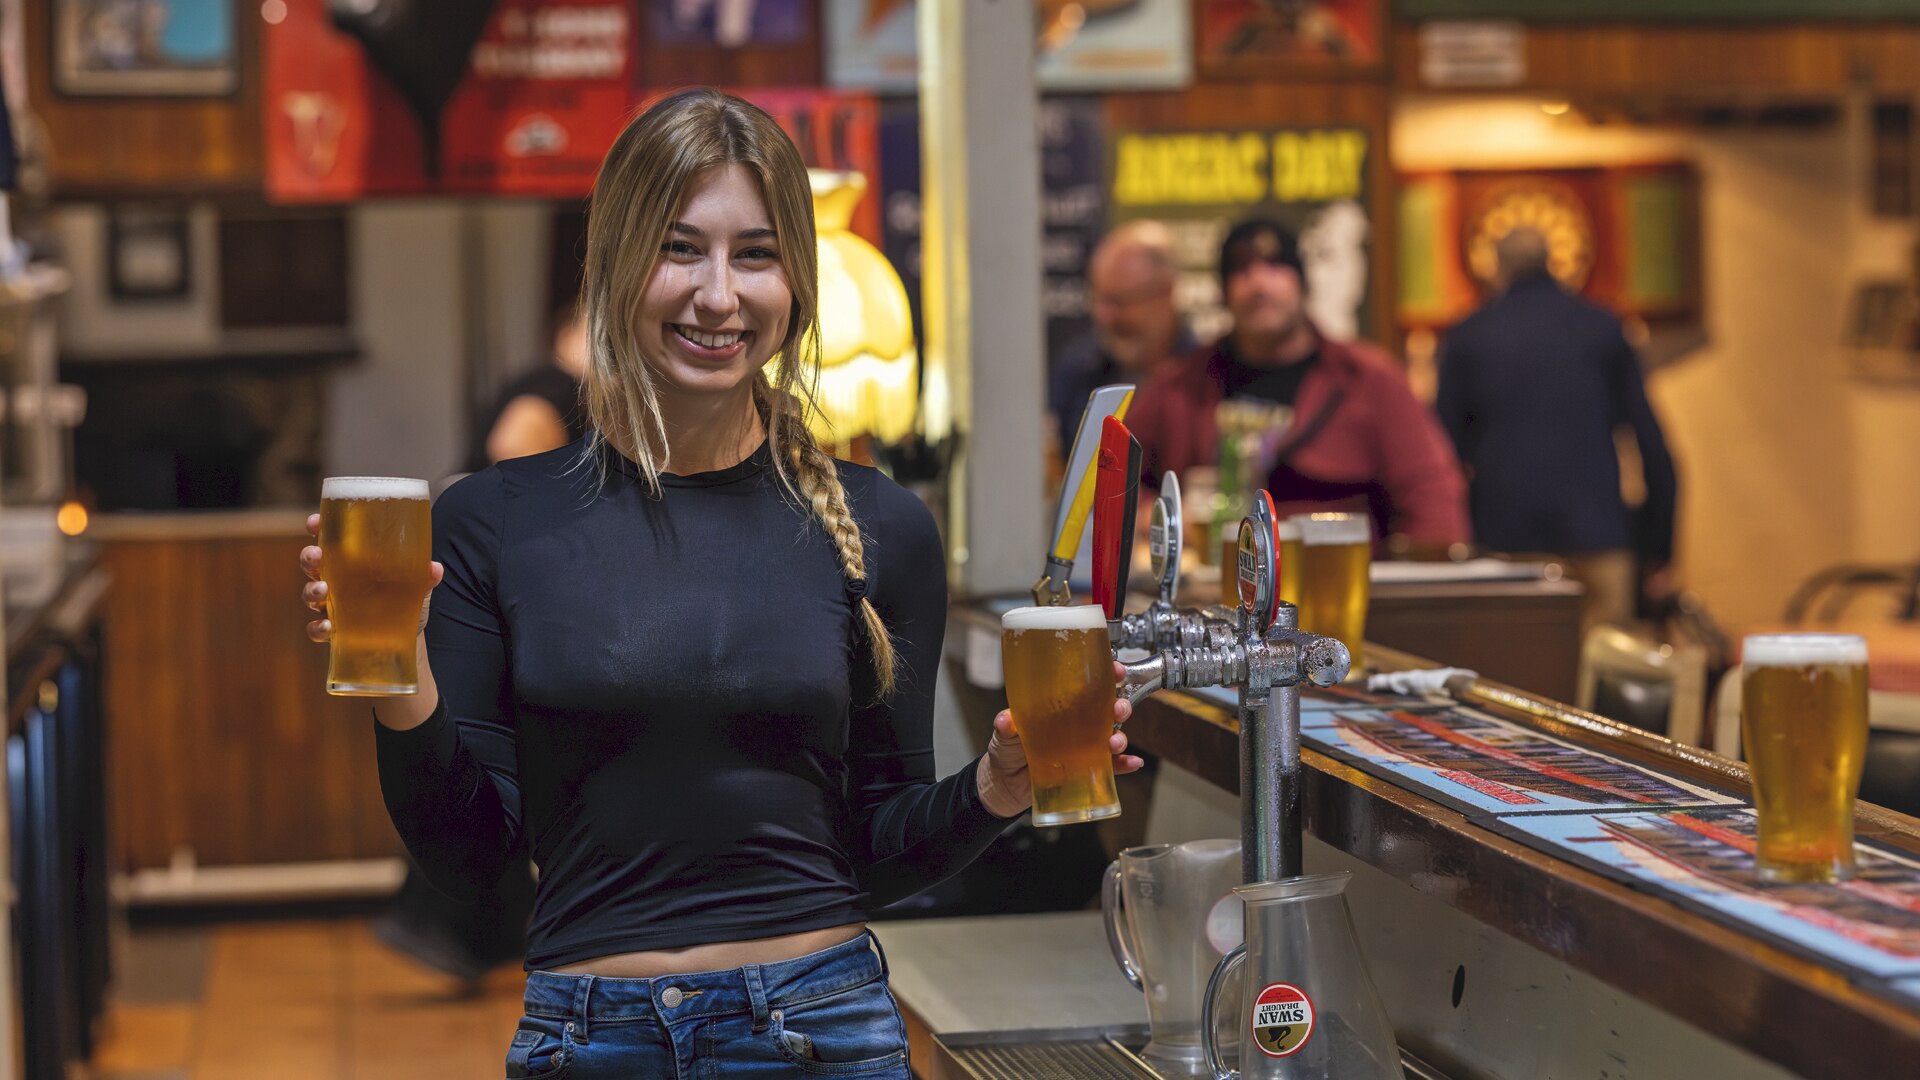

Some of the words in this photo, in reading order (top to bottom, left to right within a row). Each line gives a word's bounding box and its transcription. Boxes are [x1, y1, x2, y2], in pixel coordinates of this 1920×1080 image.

[1114, 133, 1267, 204] ANZAC
[1273, 131, 1366, 202] DAY
[1262, 1003, 1299, 1012] DRAUGHT
[1259, 1009, 1304, 1025] SWAN
